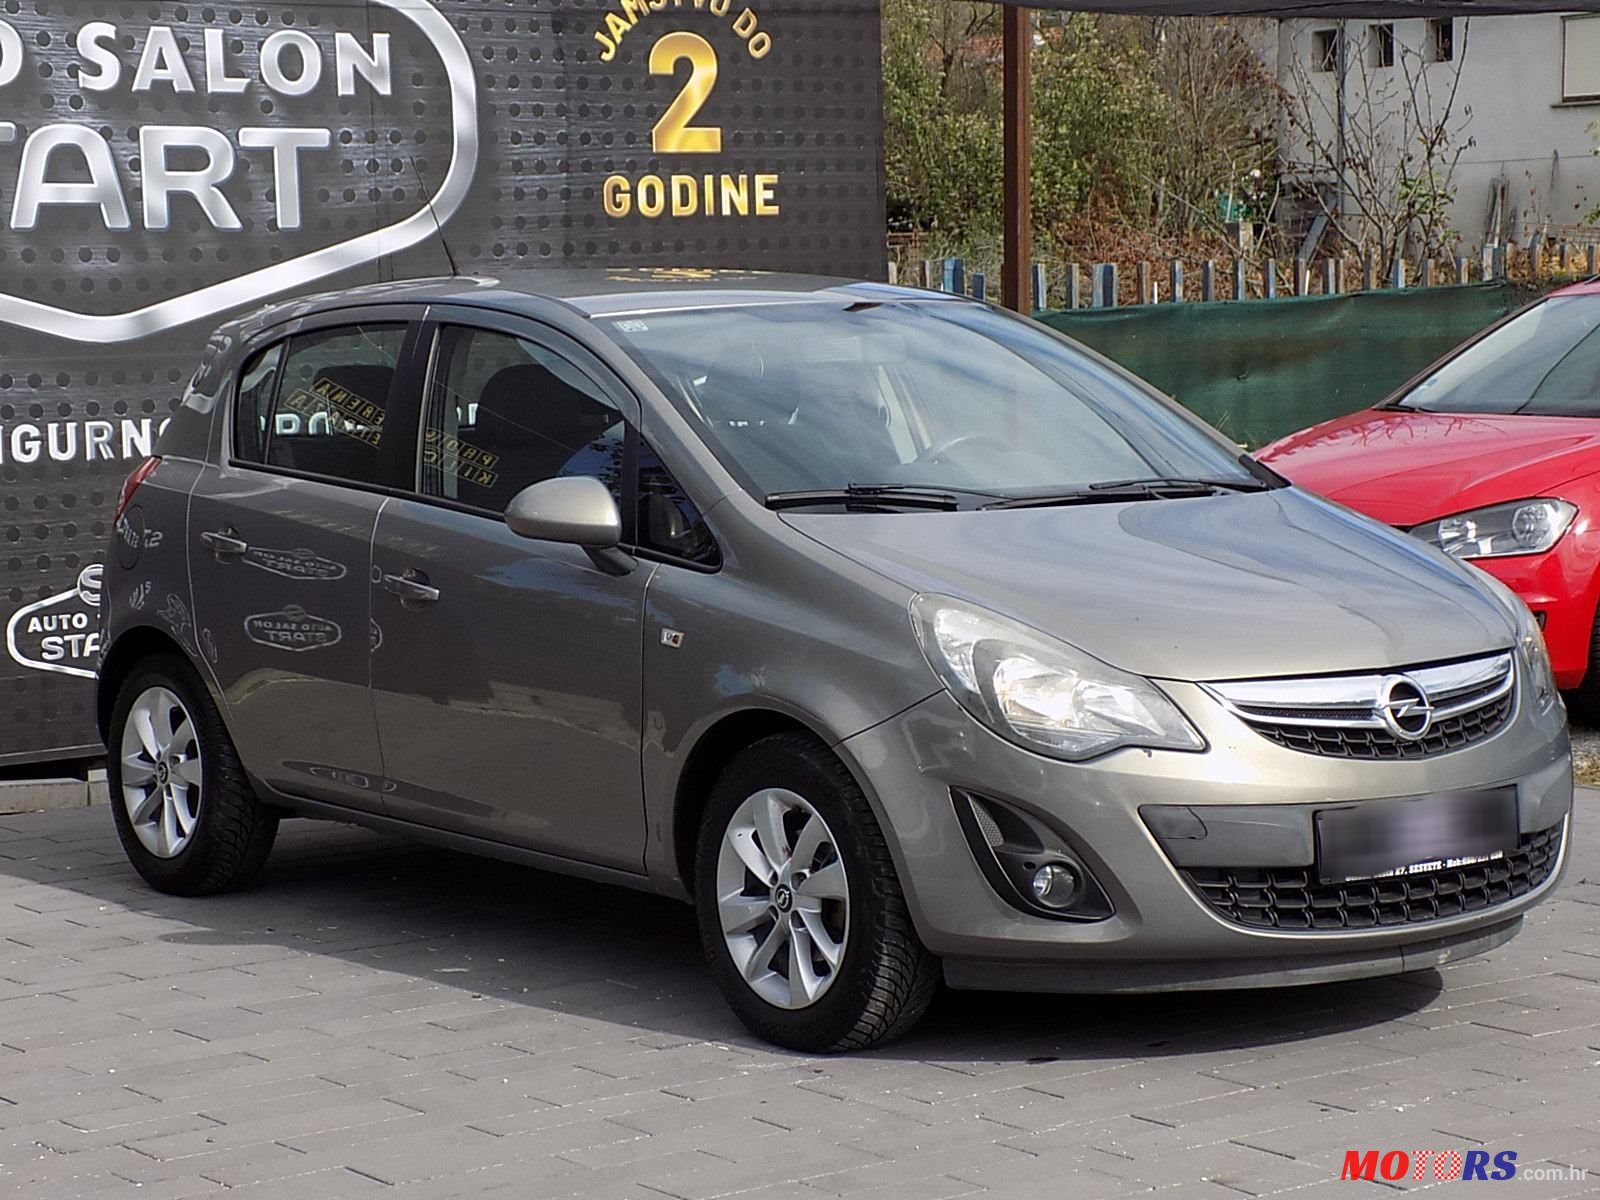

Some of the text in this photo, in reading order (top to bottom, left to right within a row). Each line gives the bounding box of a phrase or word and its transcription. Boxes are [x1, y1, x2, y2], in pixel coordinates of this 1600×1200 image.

[594, 0, 771, 61] JAMO DO
[76, 22, 393, 96] SALON
[648, 31, 723, 154] 2
[0, 121, 332, 230] ART
[603, 174, 780, 218] GODINE
[0, 418, 172, 464] GURN
[27, 613, 88, 633] AUTO
[41, 632, 100, 660] STA
